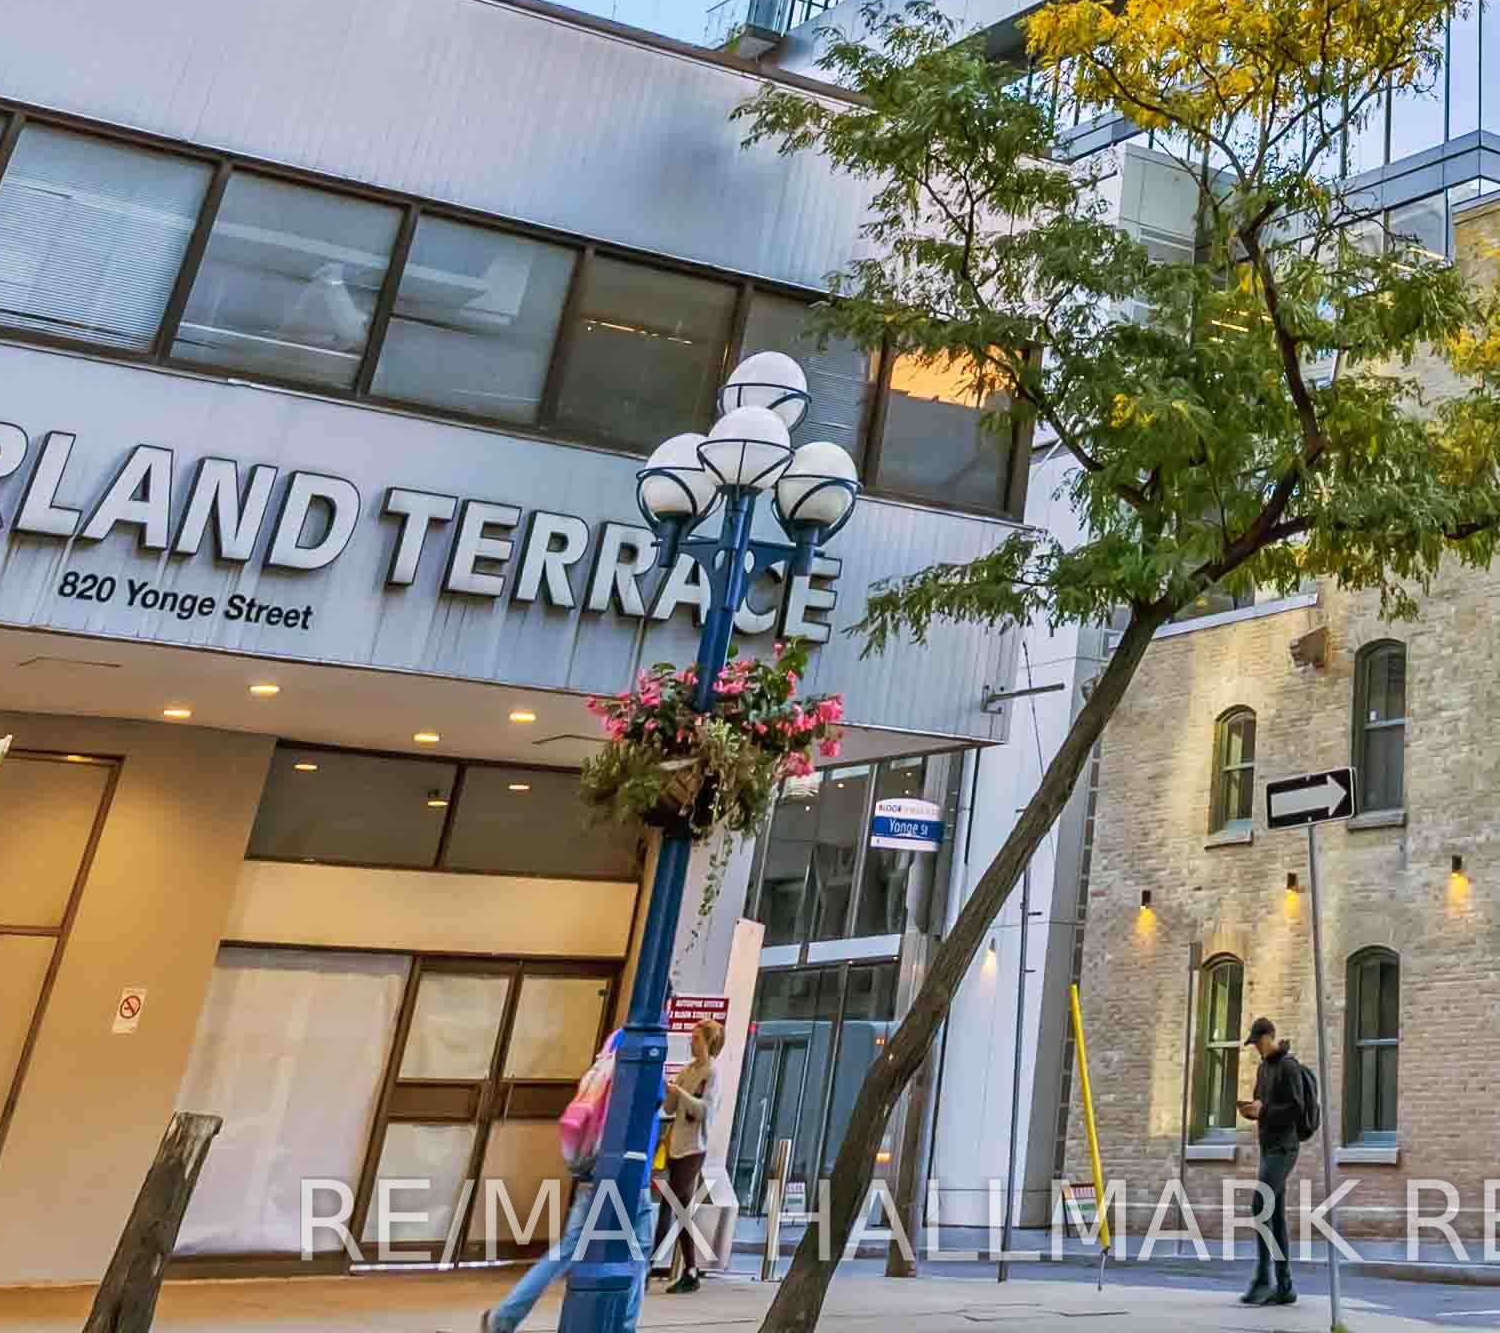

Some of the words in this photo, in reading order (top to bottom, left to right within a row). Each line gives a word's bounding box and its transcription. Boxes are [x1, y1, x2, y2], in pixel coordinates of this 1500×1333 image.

[379, 486, 844, 644] TERRACE
[57, 571, 116, 604] 820
[122, 579, 216, 621] Yonge
[223, 593, 314, 631] Street
[889, 819, 918, 837] Yonge
